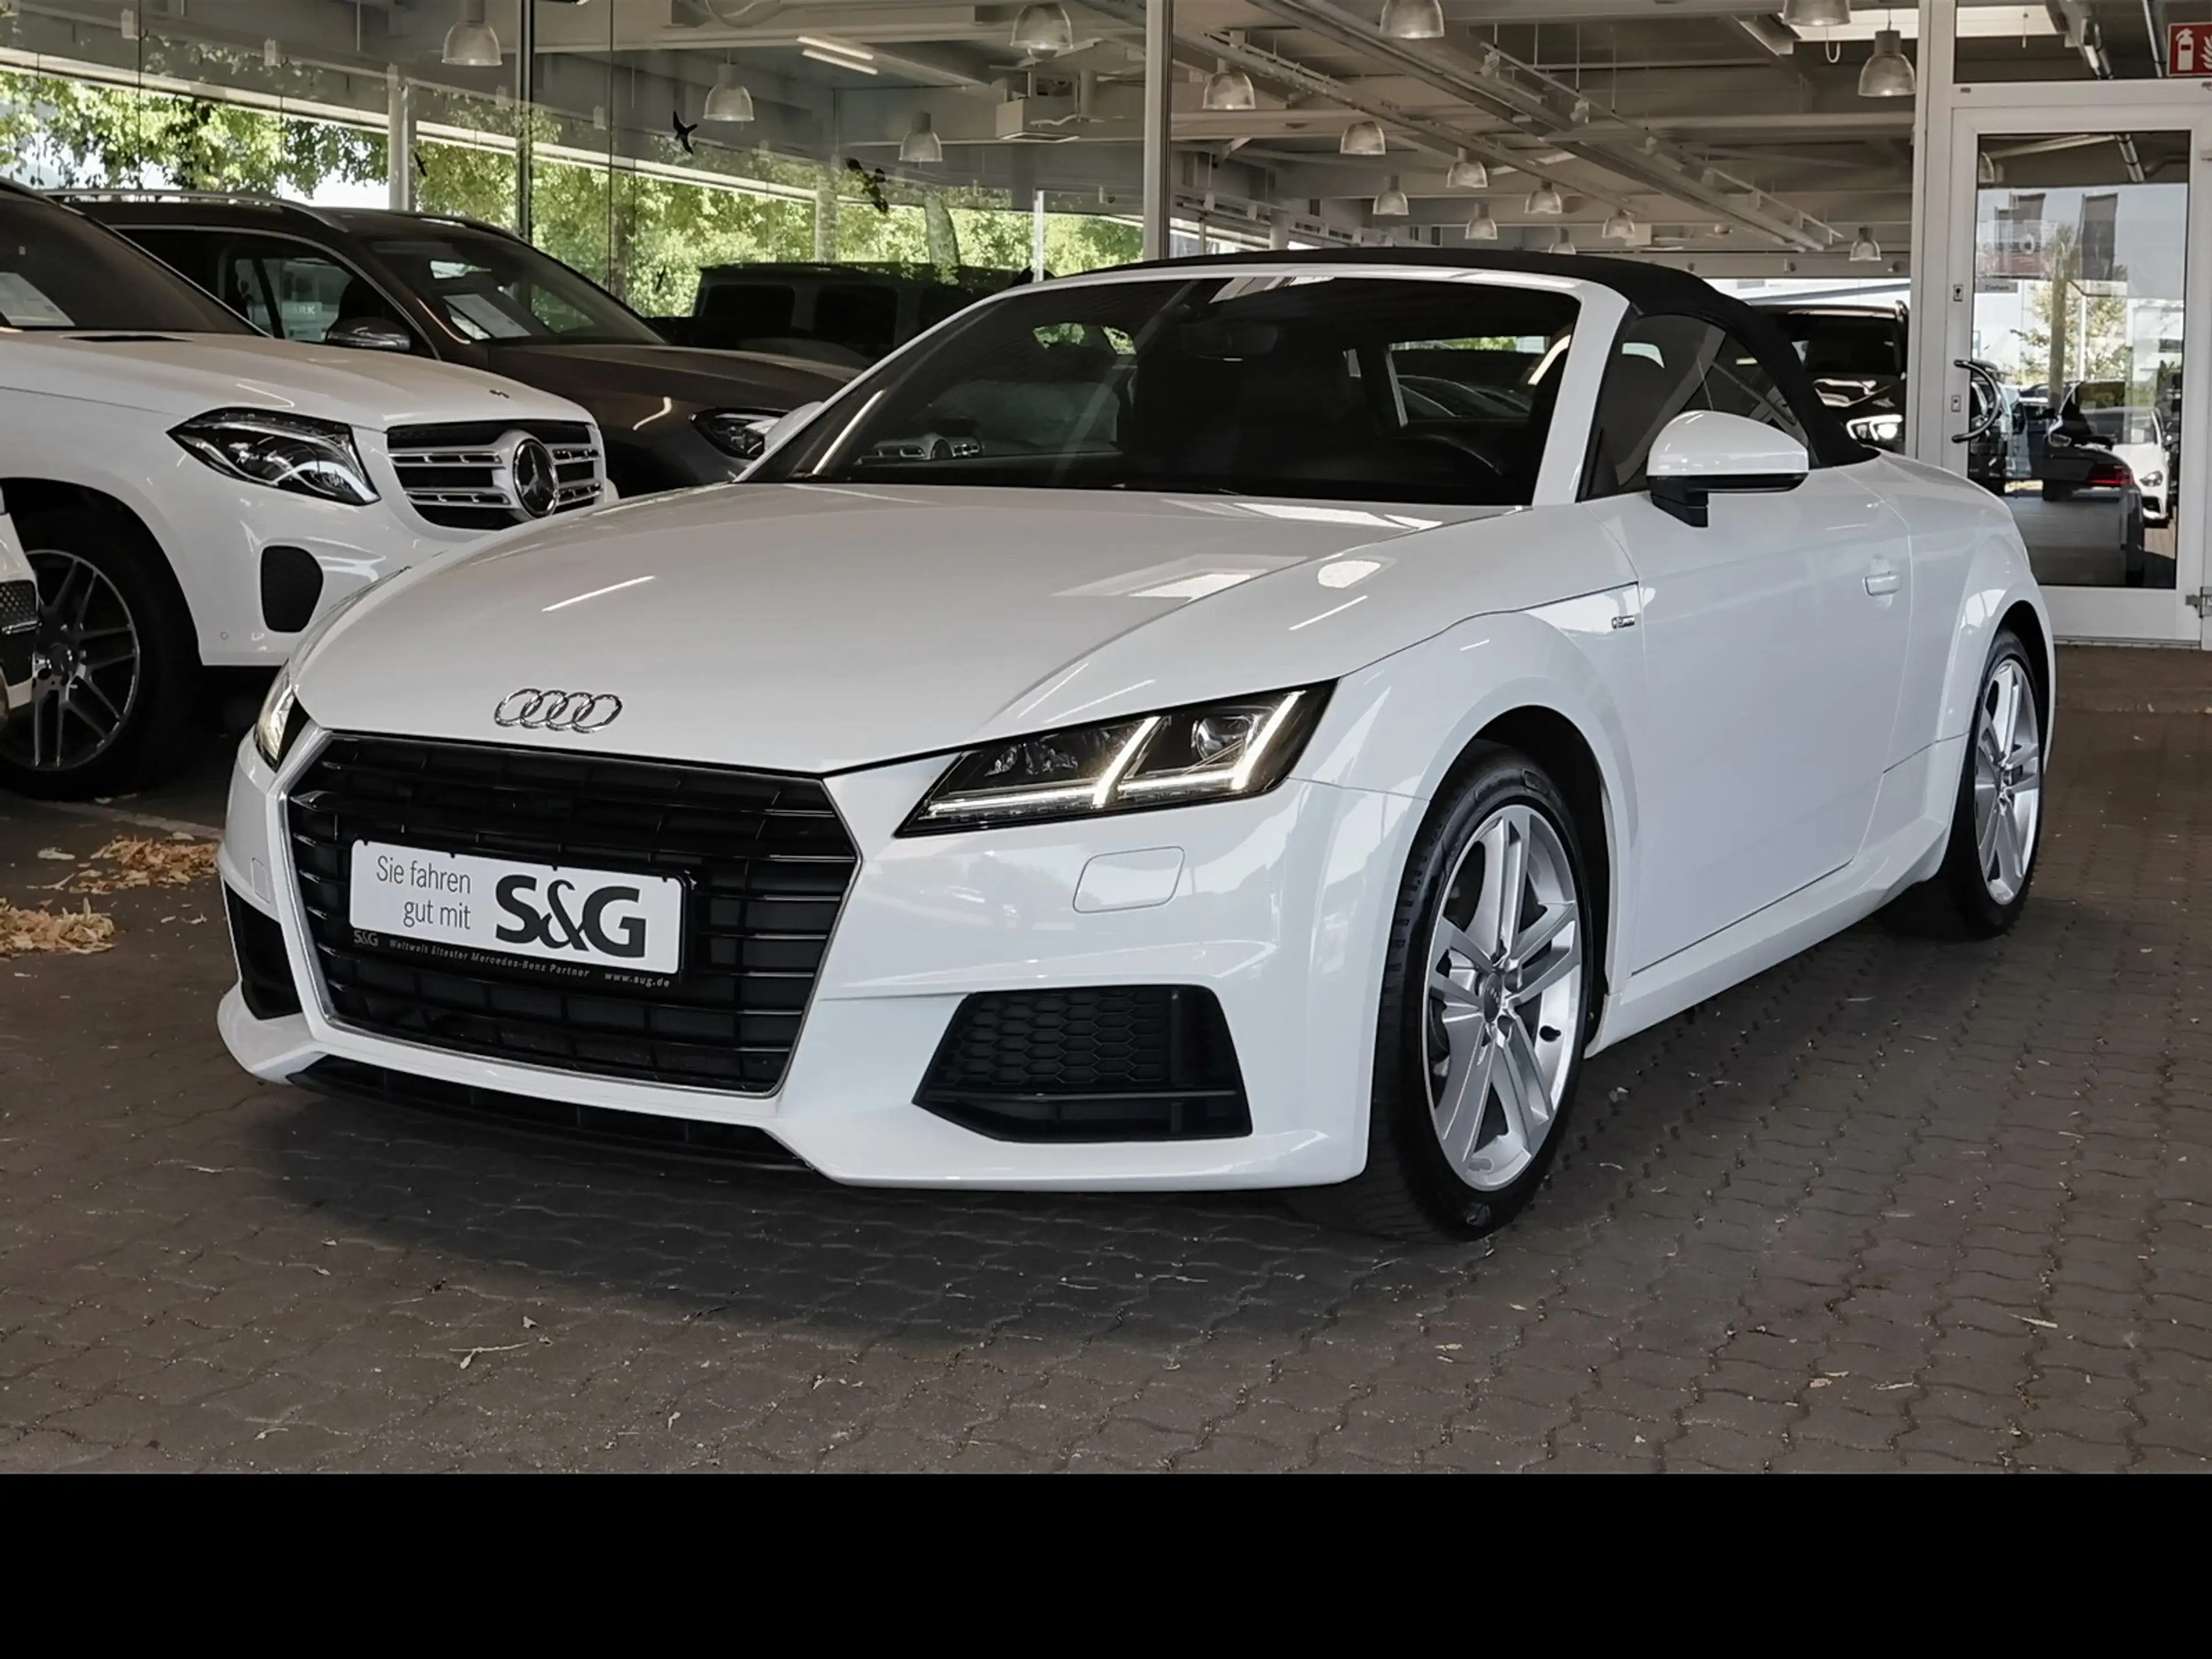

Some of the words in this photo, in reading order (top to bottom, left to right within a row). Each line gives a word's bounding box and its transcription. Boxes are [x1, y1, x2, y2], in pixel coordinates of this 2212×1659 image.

[376, 855, 404, 884] Sie
[410, 859, 471, 894] fahren
[403, 900, 433, 928] gut
[440, 902, 471, 930] mit
[495, 874, 647, 959] S&G
[353, 930, 378, 946] S&G
[471, 952, 546, 972] Mercedes-Benz
[550, 963, 590, 978] Partner
[604, 973, 671, 988] www.sug.de
